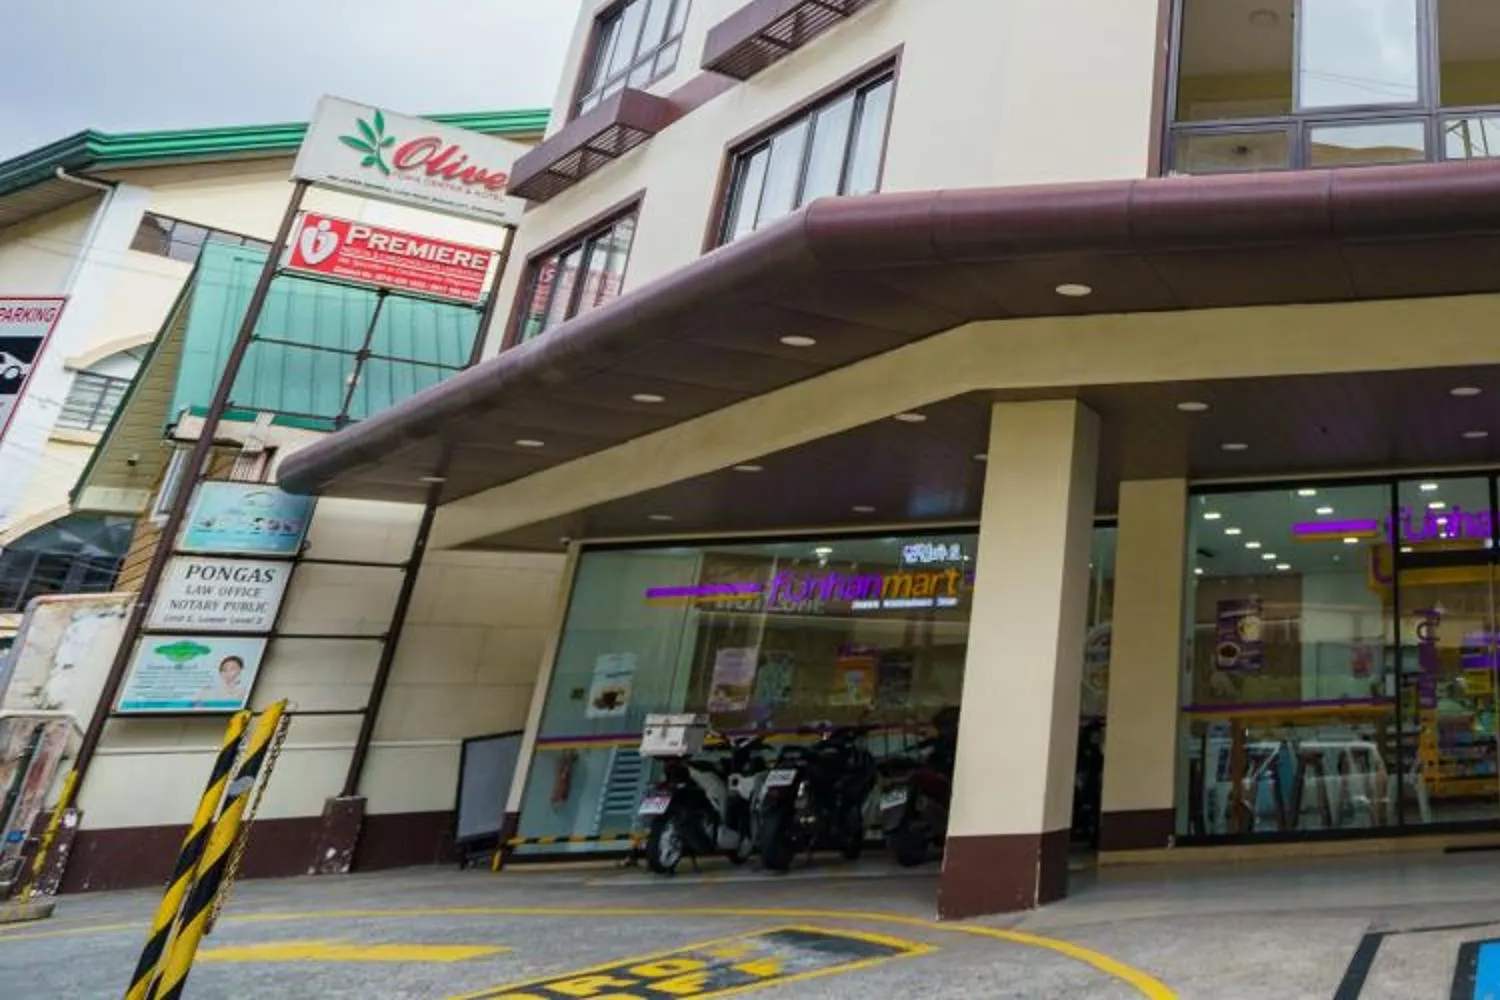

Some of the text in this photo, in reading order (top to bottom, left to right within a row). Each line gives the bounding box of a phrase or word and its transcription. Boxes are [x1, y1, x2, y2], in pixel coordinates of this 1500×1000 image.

[392, 136, 508, 190] Olive
[346, 224, 489, 270] PREMIERE
[185, 564, 277, 584] PONGAS
[186, 584, 264, 598] LAW OFFICE
[169, 599, 270, 614] NOTARY PUBLIC
